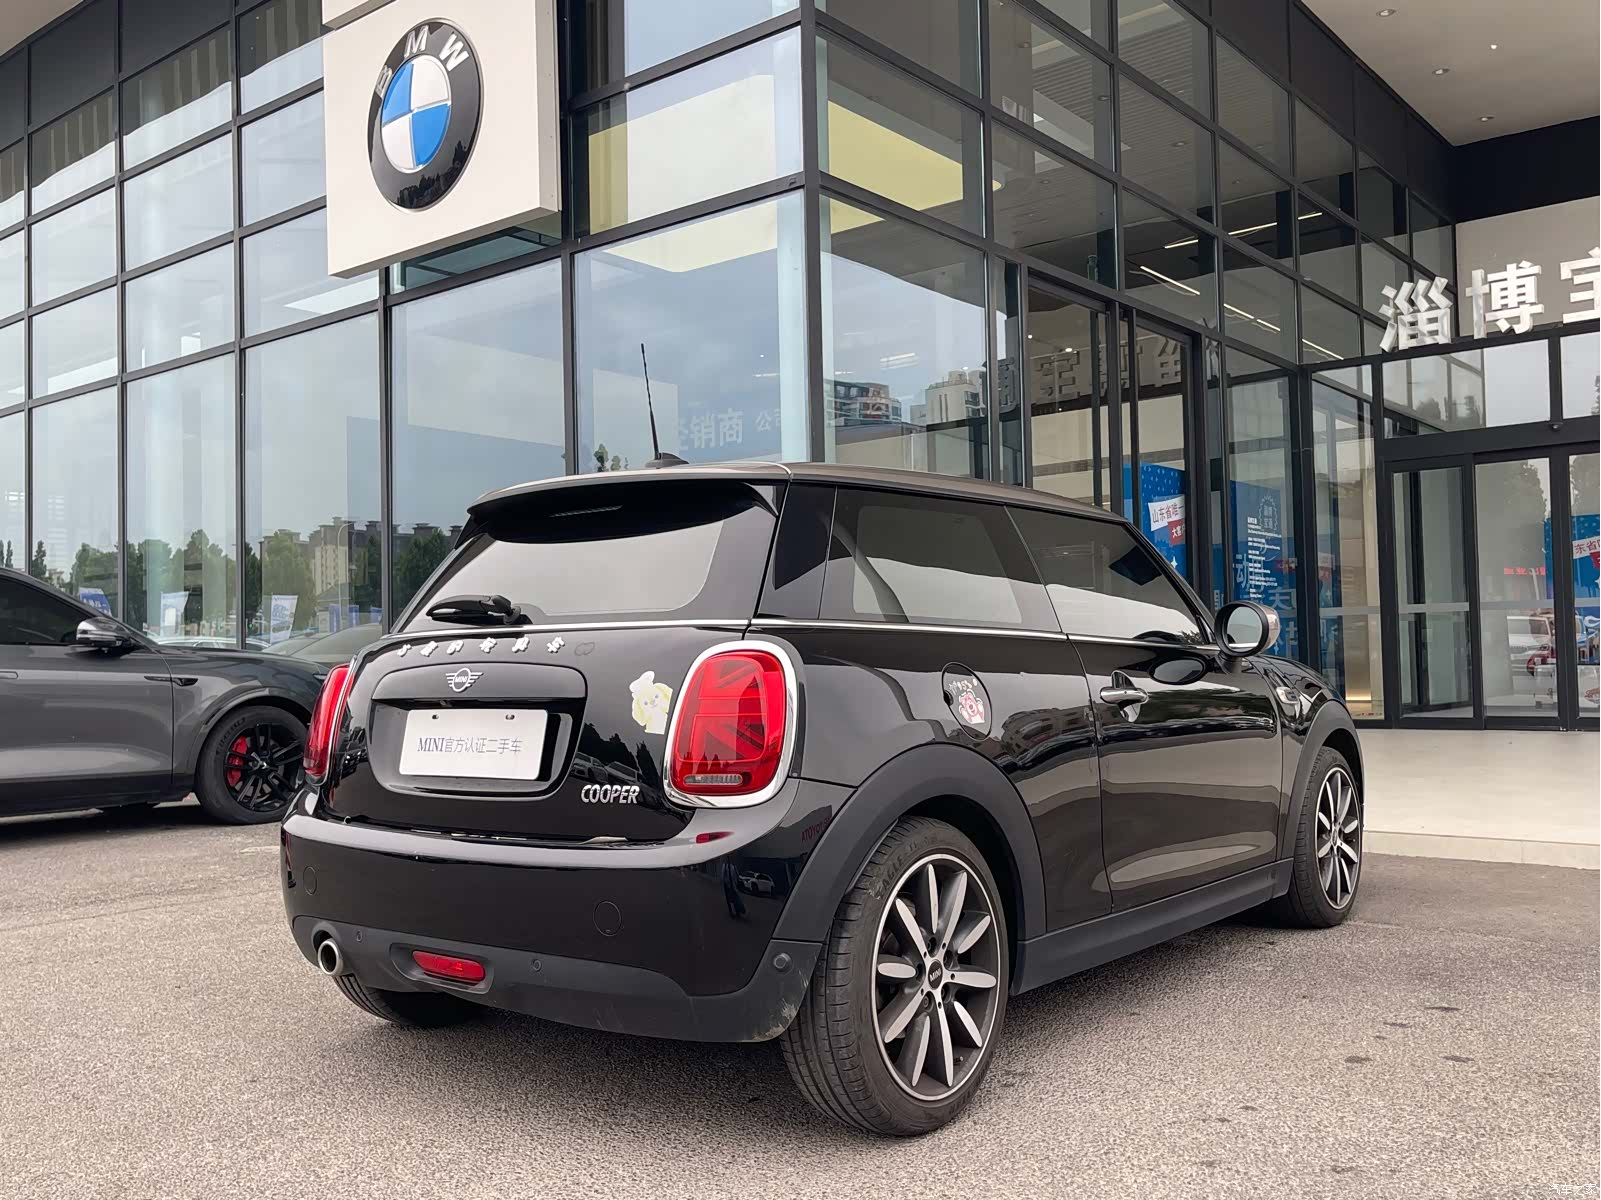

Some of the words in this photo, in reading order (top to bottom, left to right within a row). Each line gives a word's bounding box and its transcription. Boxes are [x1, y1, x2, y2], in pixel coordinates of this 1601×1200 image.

[375, 25, 469, 98] BMW
[1152, 502, 1185, 523] 山东省唯一
[417, 737, 523, 754] MINI官方认证二手车
[580, 785, 639, 804] COOPER
